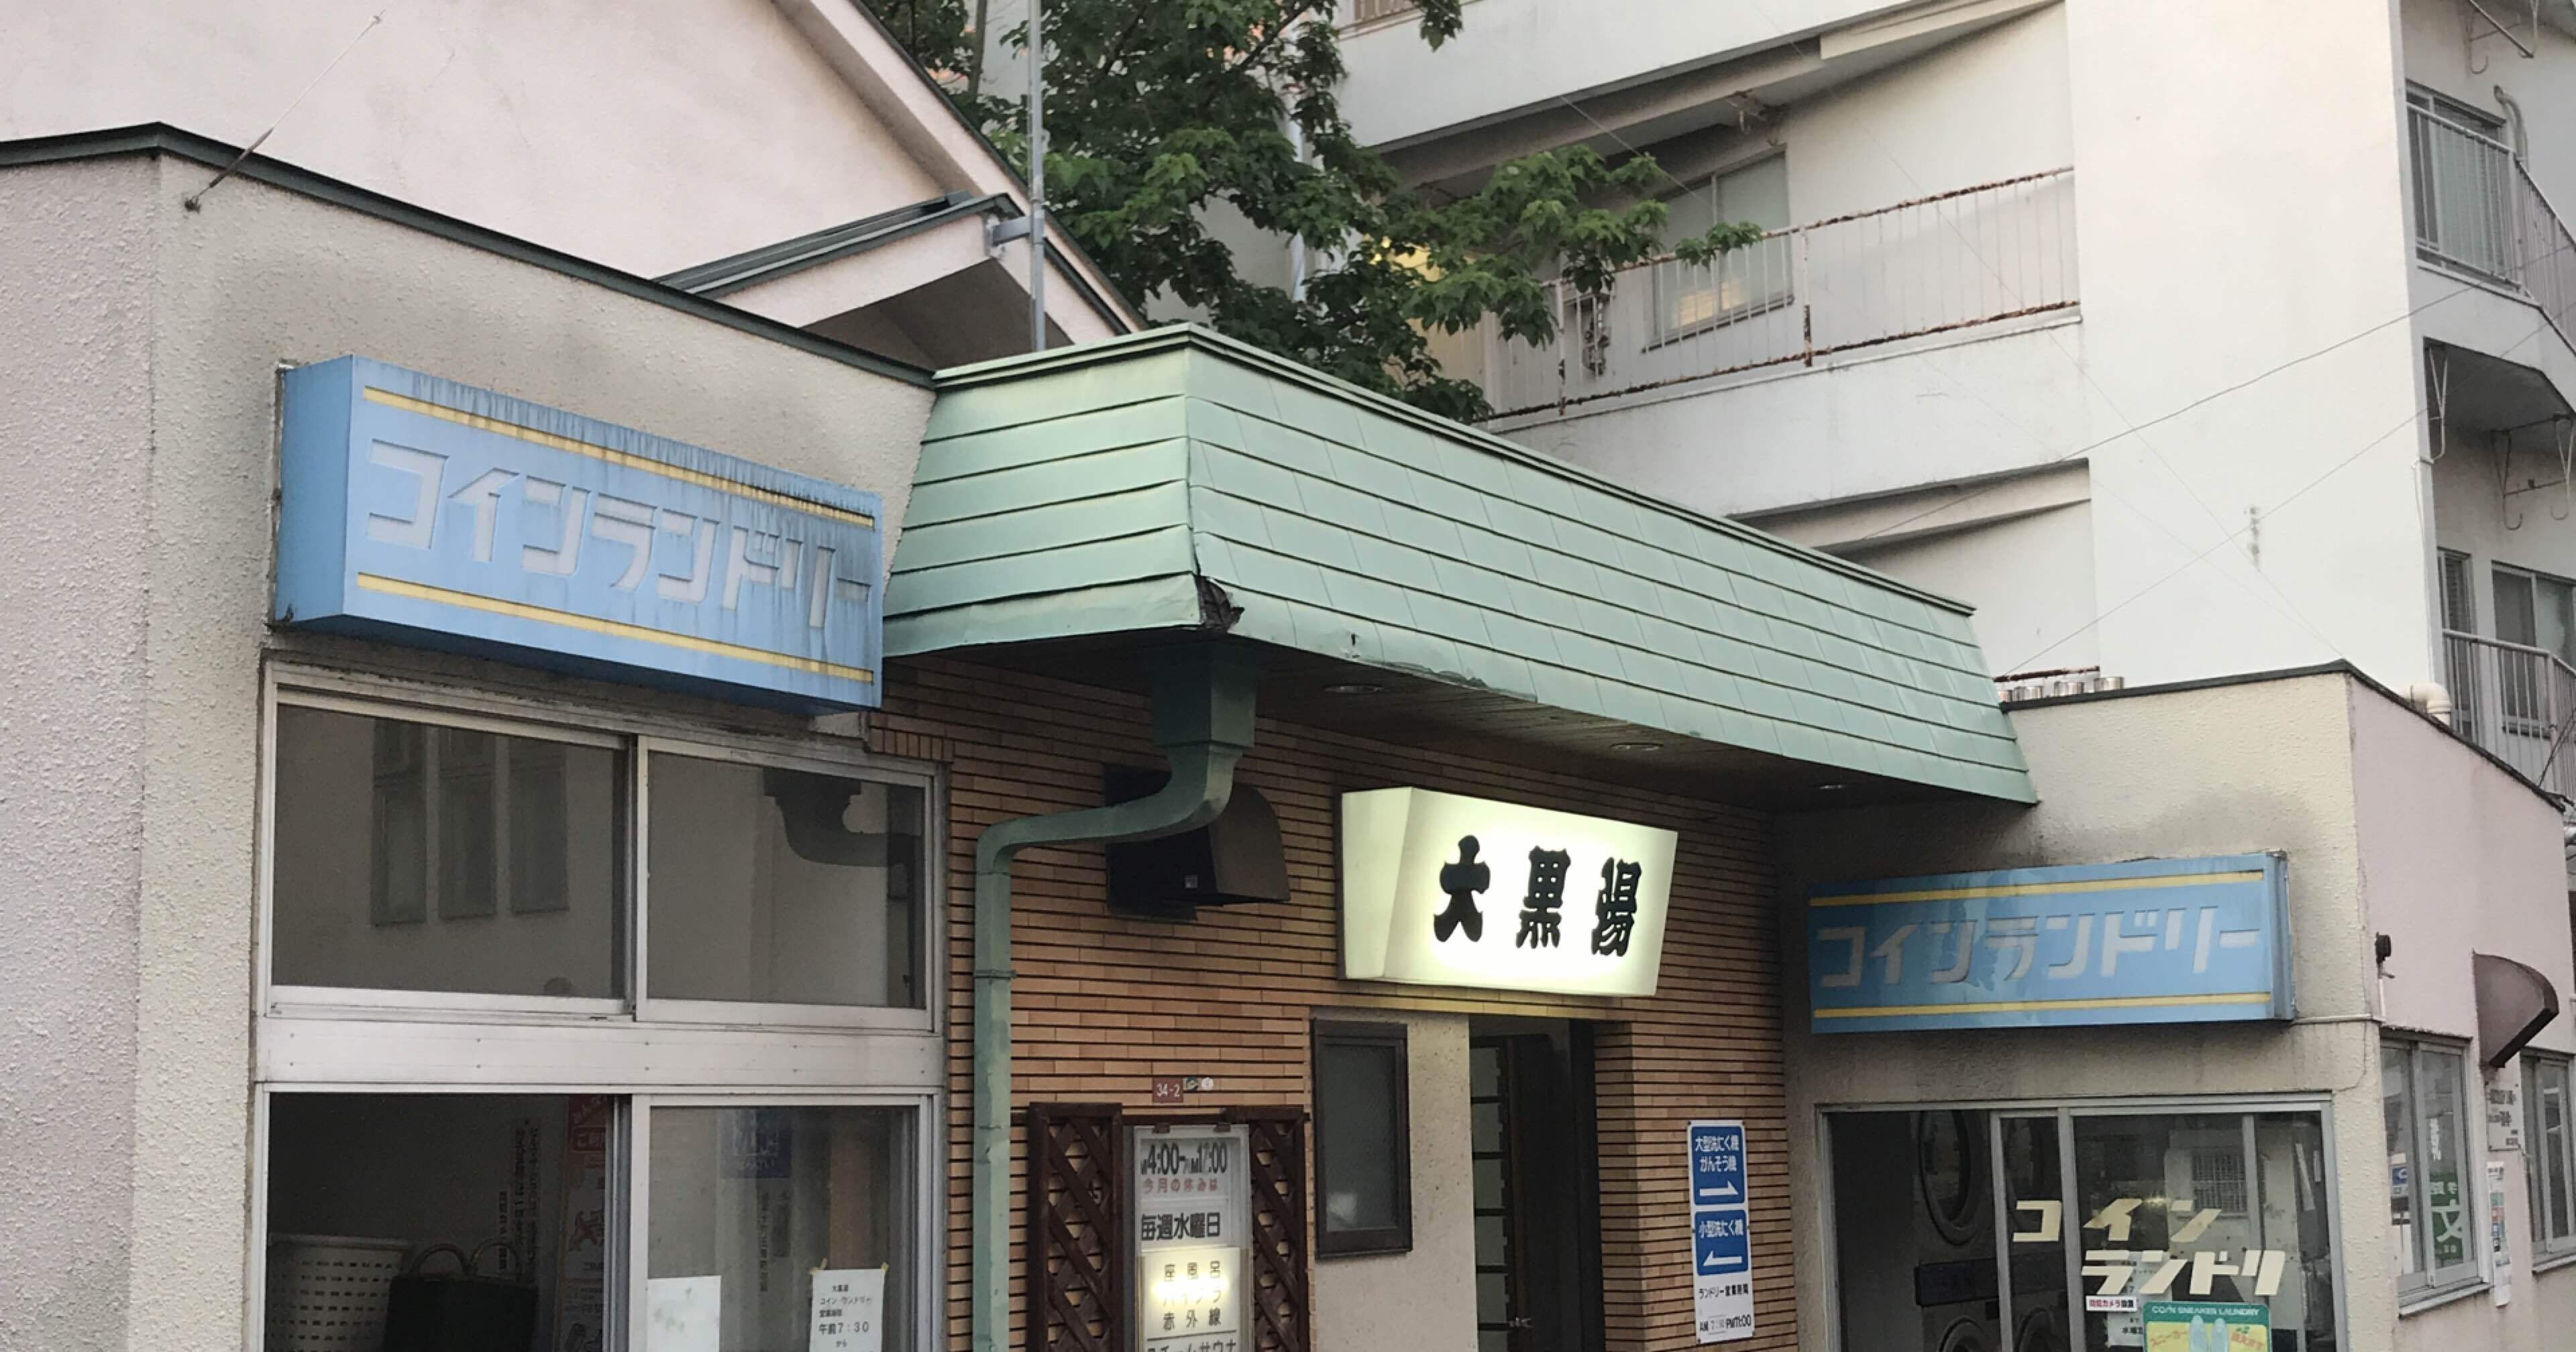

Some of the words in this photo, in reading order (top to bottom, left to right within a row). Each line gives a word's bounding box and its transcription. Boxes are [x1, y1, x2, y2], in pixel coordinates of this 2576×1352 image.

[368, 439, 869, 629] コインランドリー
[1433, 834, 1642, 957] 大黒湯
[1815, 905, 2260, 987] コインランドリー
[1157, 1083, 1181, 1098] 34-2
[1142, 1177, 1218, 1194] 今月の休みは
[1141, 1212, 1220, 1241] 毎週水曜日
[2012, 1198, 2222, 1243] コイン
[1163, 1307, 1221, 1331] 赤外線
[2218, 1307, 2260, 1316] LAUNDRY
